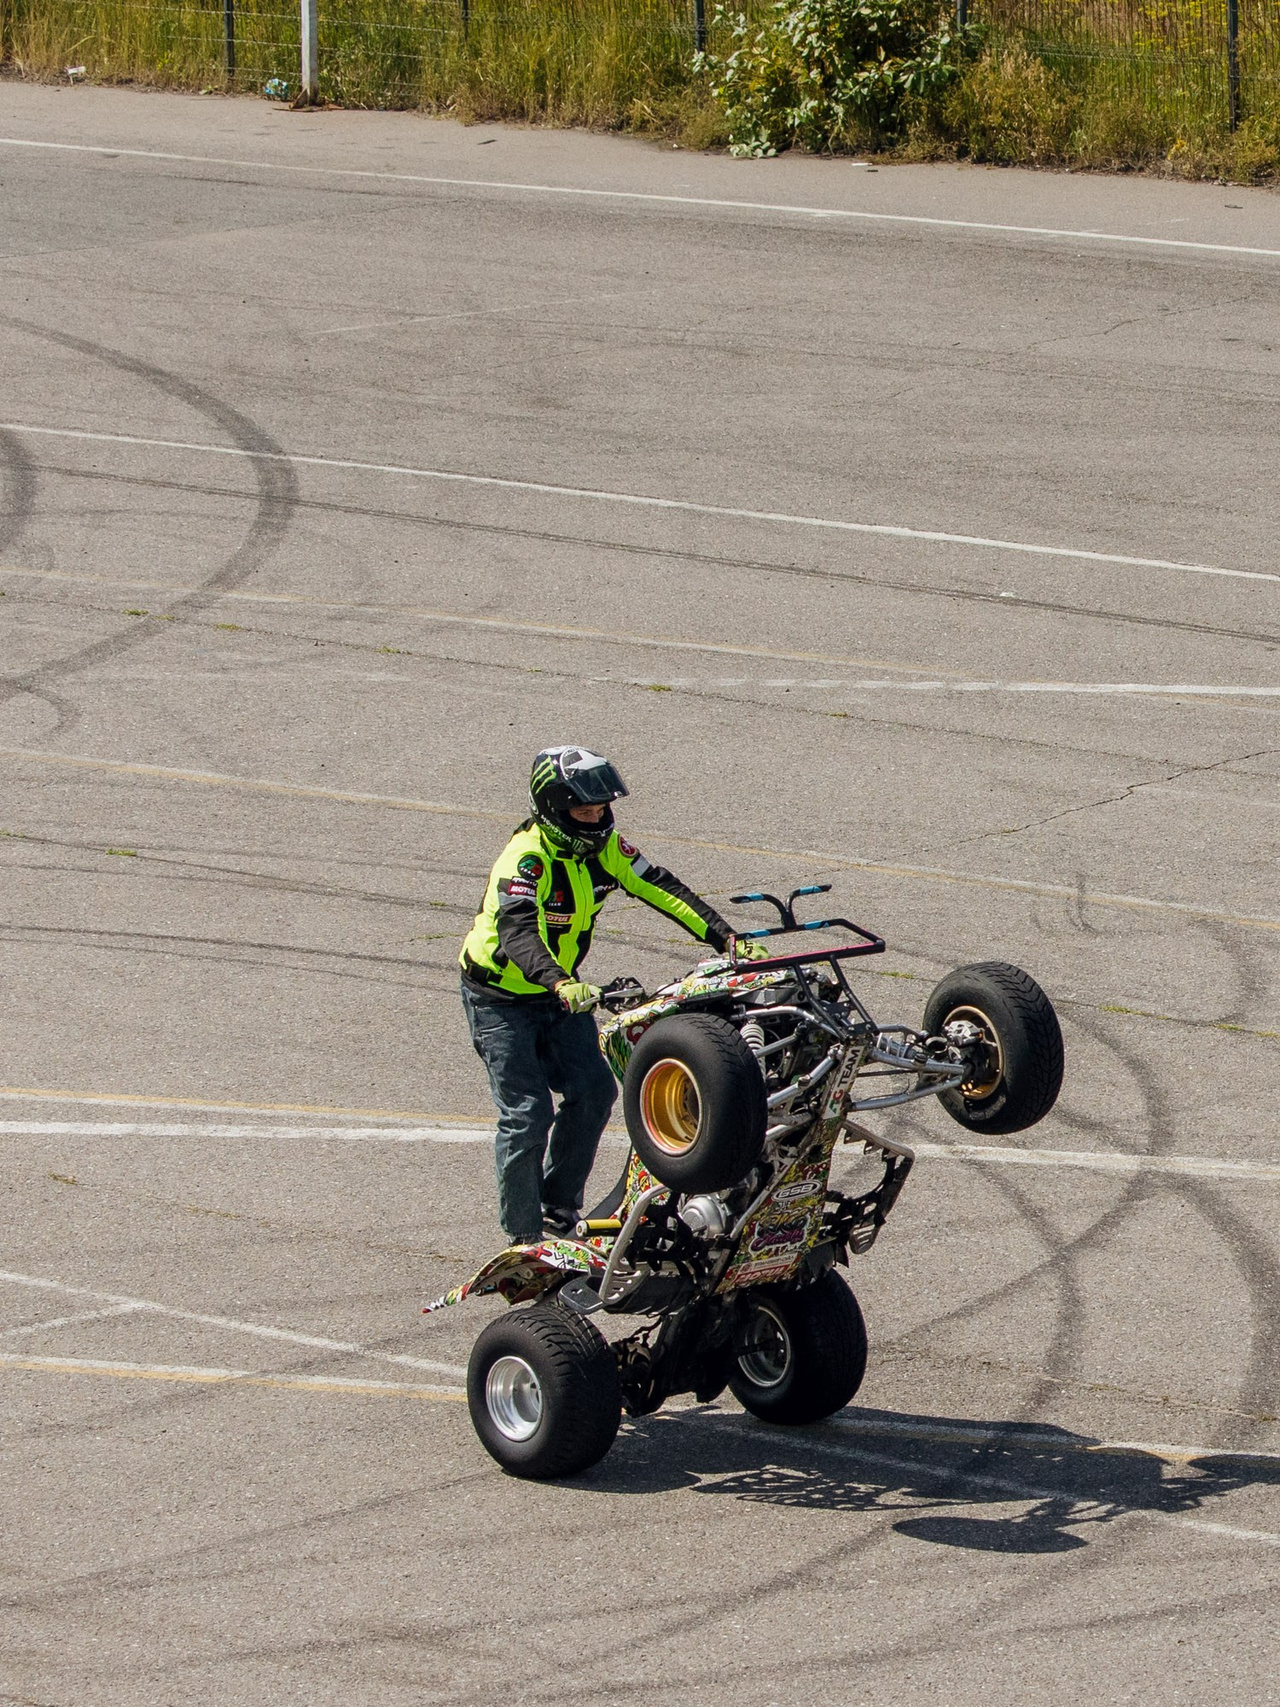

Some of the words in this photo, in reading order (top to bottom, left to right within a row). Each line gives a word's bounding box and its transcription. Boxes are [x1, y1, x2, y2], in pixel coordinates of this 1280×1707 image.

[540, 814, 572, 842] MONSTER
[520, 867, 536, 876] TEAM
[510, 886, 536, 896] MOTUL
[837, 1049, 860, 1087] TEAM
